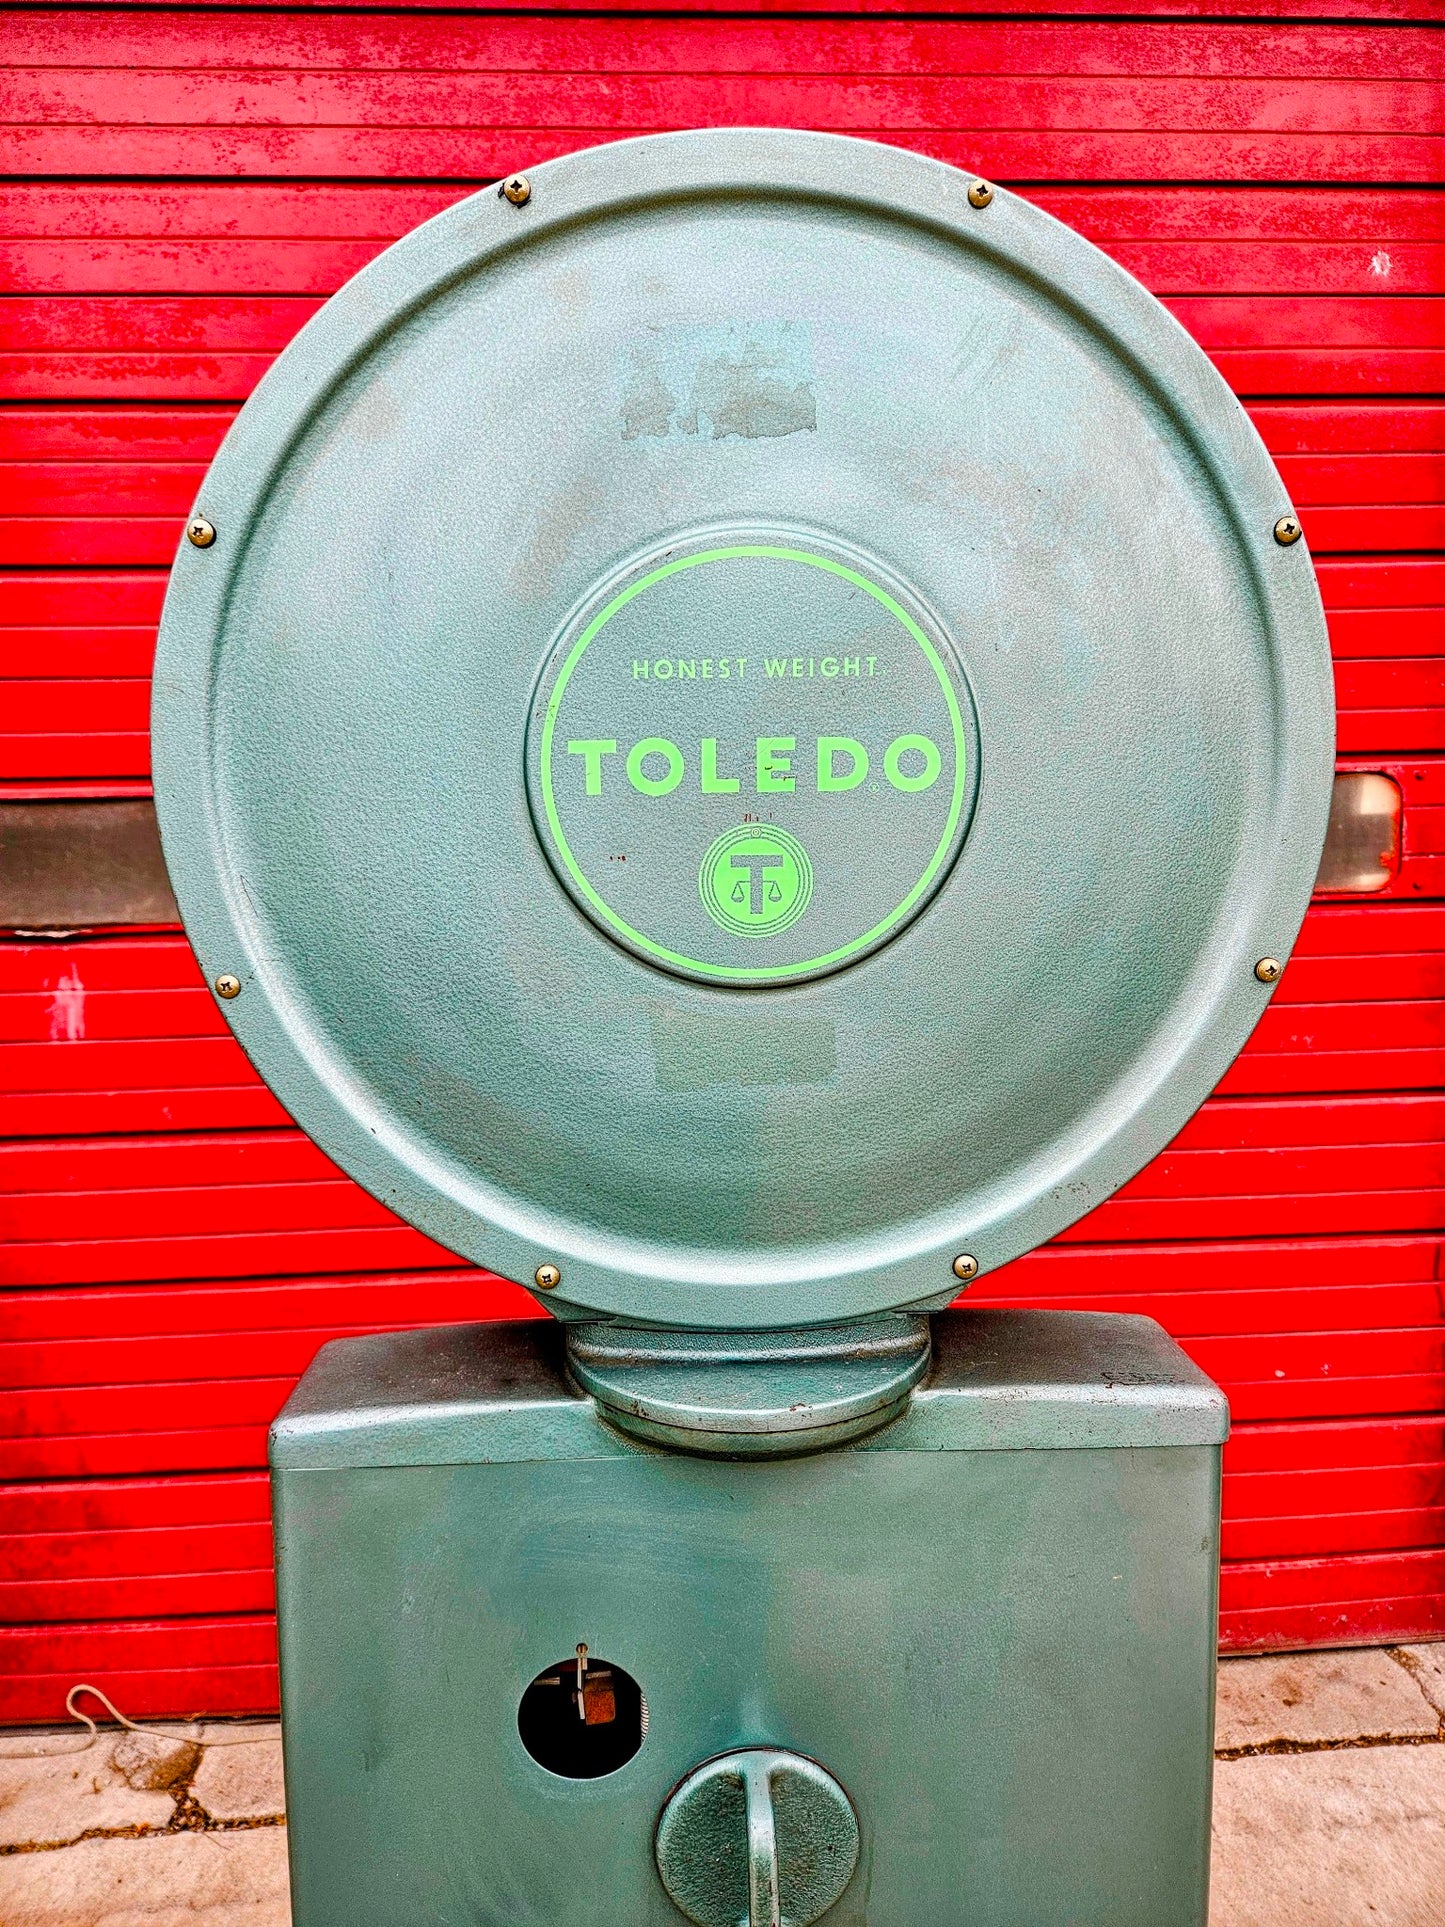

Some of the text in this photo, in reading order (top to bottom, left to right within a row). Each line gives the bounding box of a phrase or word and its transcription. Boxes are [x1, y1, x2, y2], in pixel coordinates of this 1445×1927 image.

[633, 656, 878, 679] HONEST WEIGHT
[567, 734, 942, 796] TOLEDO
